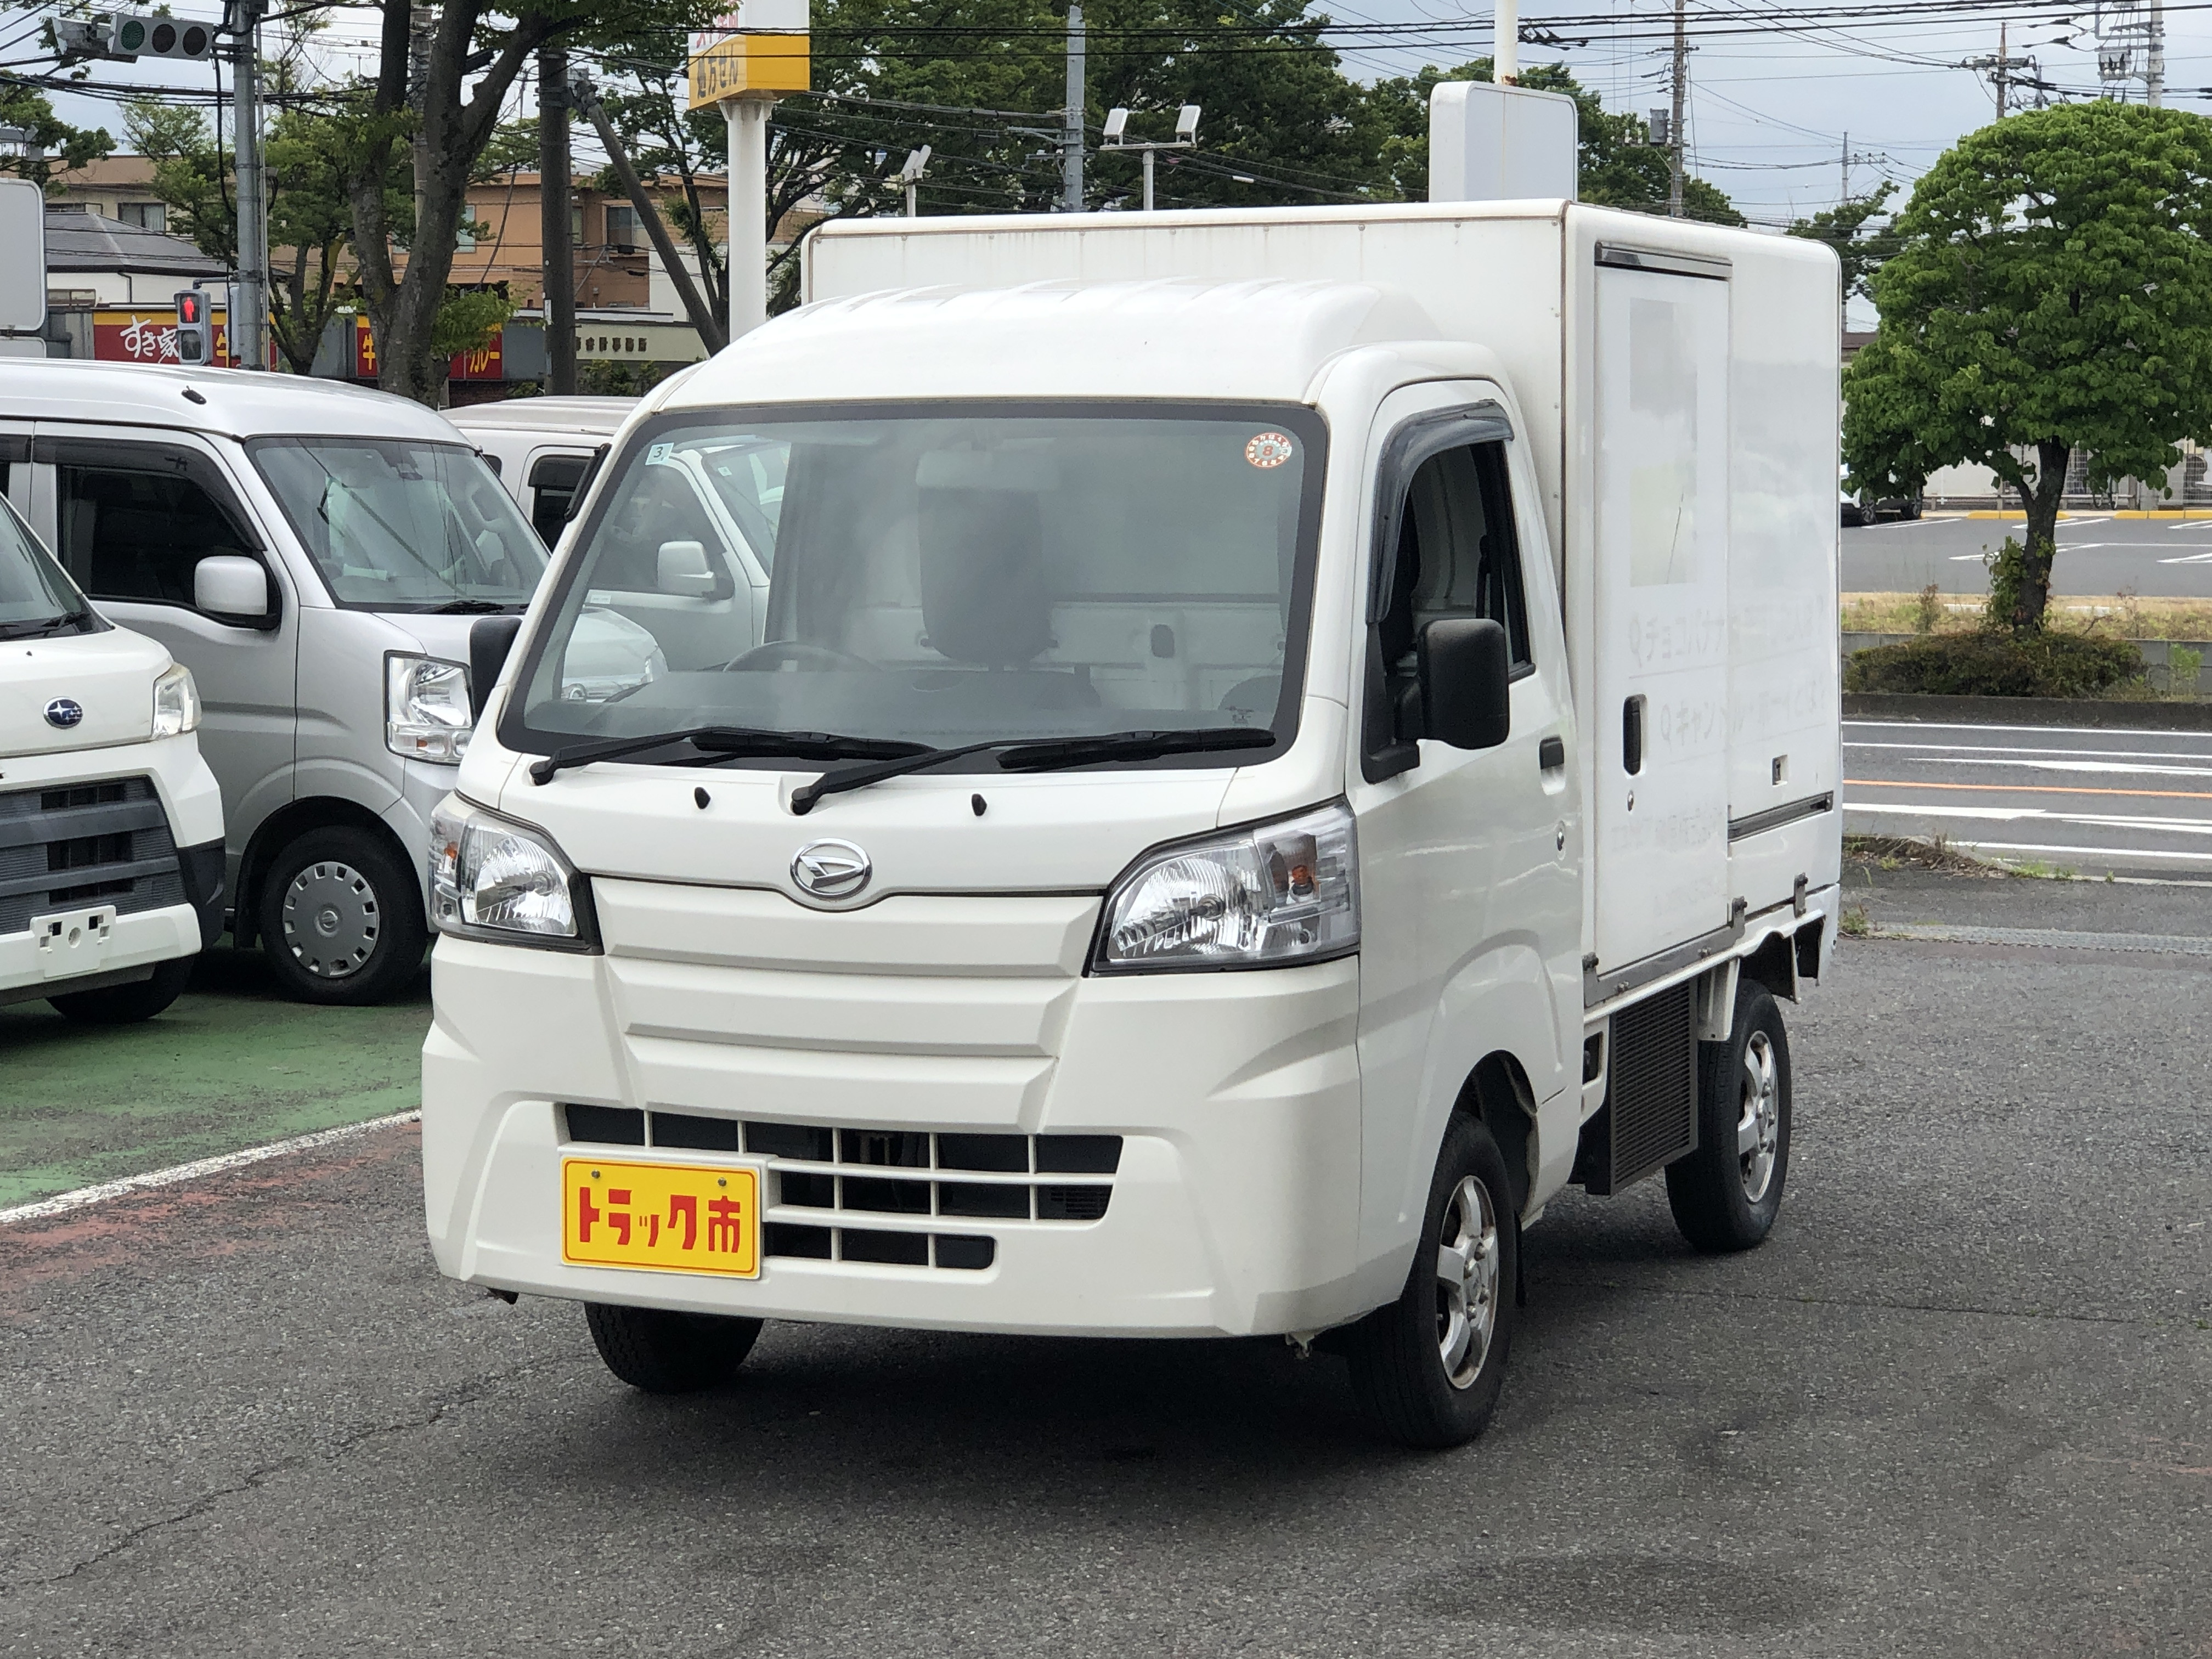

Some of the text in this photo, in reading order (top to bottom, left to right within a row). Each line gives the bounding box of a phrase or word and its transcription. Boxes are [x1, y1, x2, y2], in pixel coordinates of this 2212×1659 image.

[120, 314, 179, 363] すき家
[653, 446, 663, 458] 3
[1262, 445, 1273, 456] 8
[579, 1186, 741, 1254] トラック市
